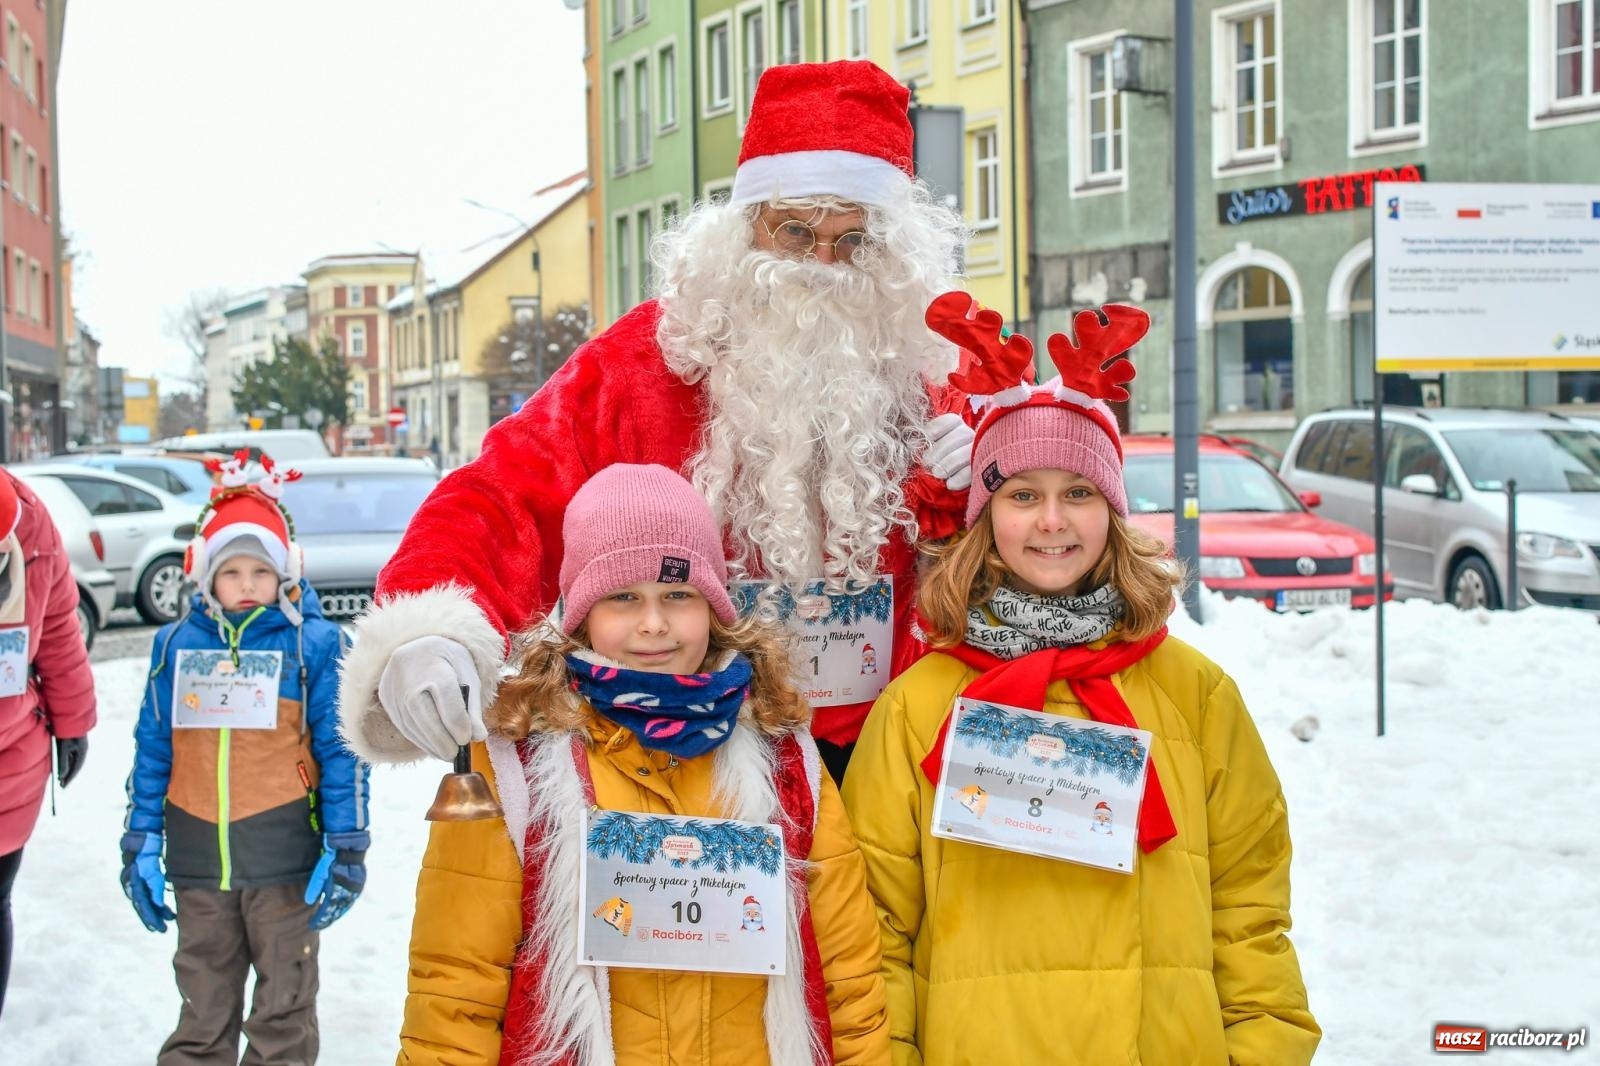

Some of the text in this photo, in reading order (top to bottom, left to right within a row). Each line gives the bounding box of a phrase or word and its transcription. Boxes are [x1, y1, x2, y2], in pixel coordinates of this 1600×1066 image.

[1226, 187, 1293, 224] Sailor
[664, 558, 688, 569] BEAUTY
[670, 568, 680, 576] OF
[821, 635, 829, 653] z
[809, 655, 819, 676] 1
[220, 694, 228, 706] 2
[803, 688, 833, 699] cibórz
[974, 762, 1015, 785] Sportowy
[1018, 772, 1047, 785] spacer
[1045, 778, 1054, 797] z
[1027, 797, 1043, 818] 8
[1005, 817, 1053, 834] Racibórz
[613, 872, 657, 892] Sportowy
[658, 878, 689, 890] spacer
[690, 880, 698, 898] z
[671, 900, 702, 924] 10
[652, 929, 703, 942] Racibórz
